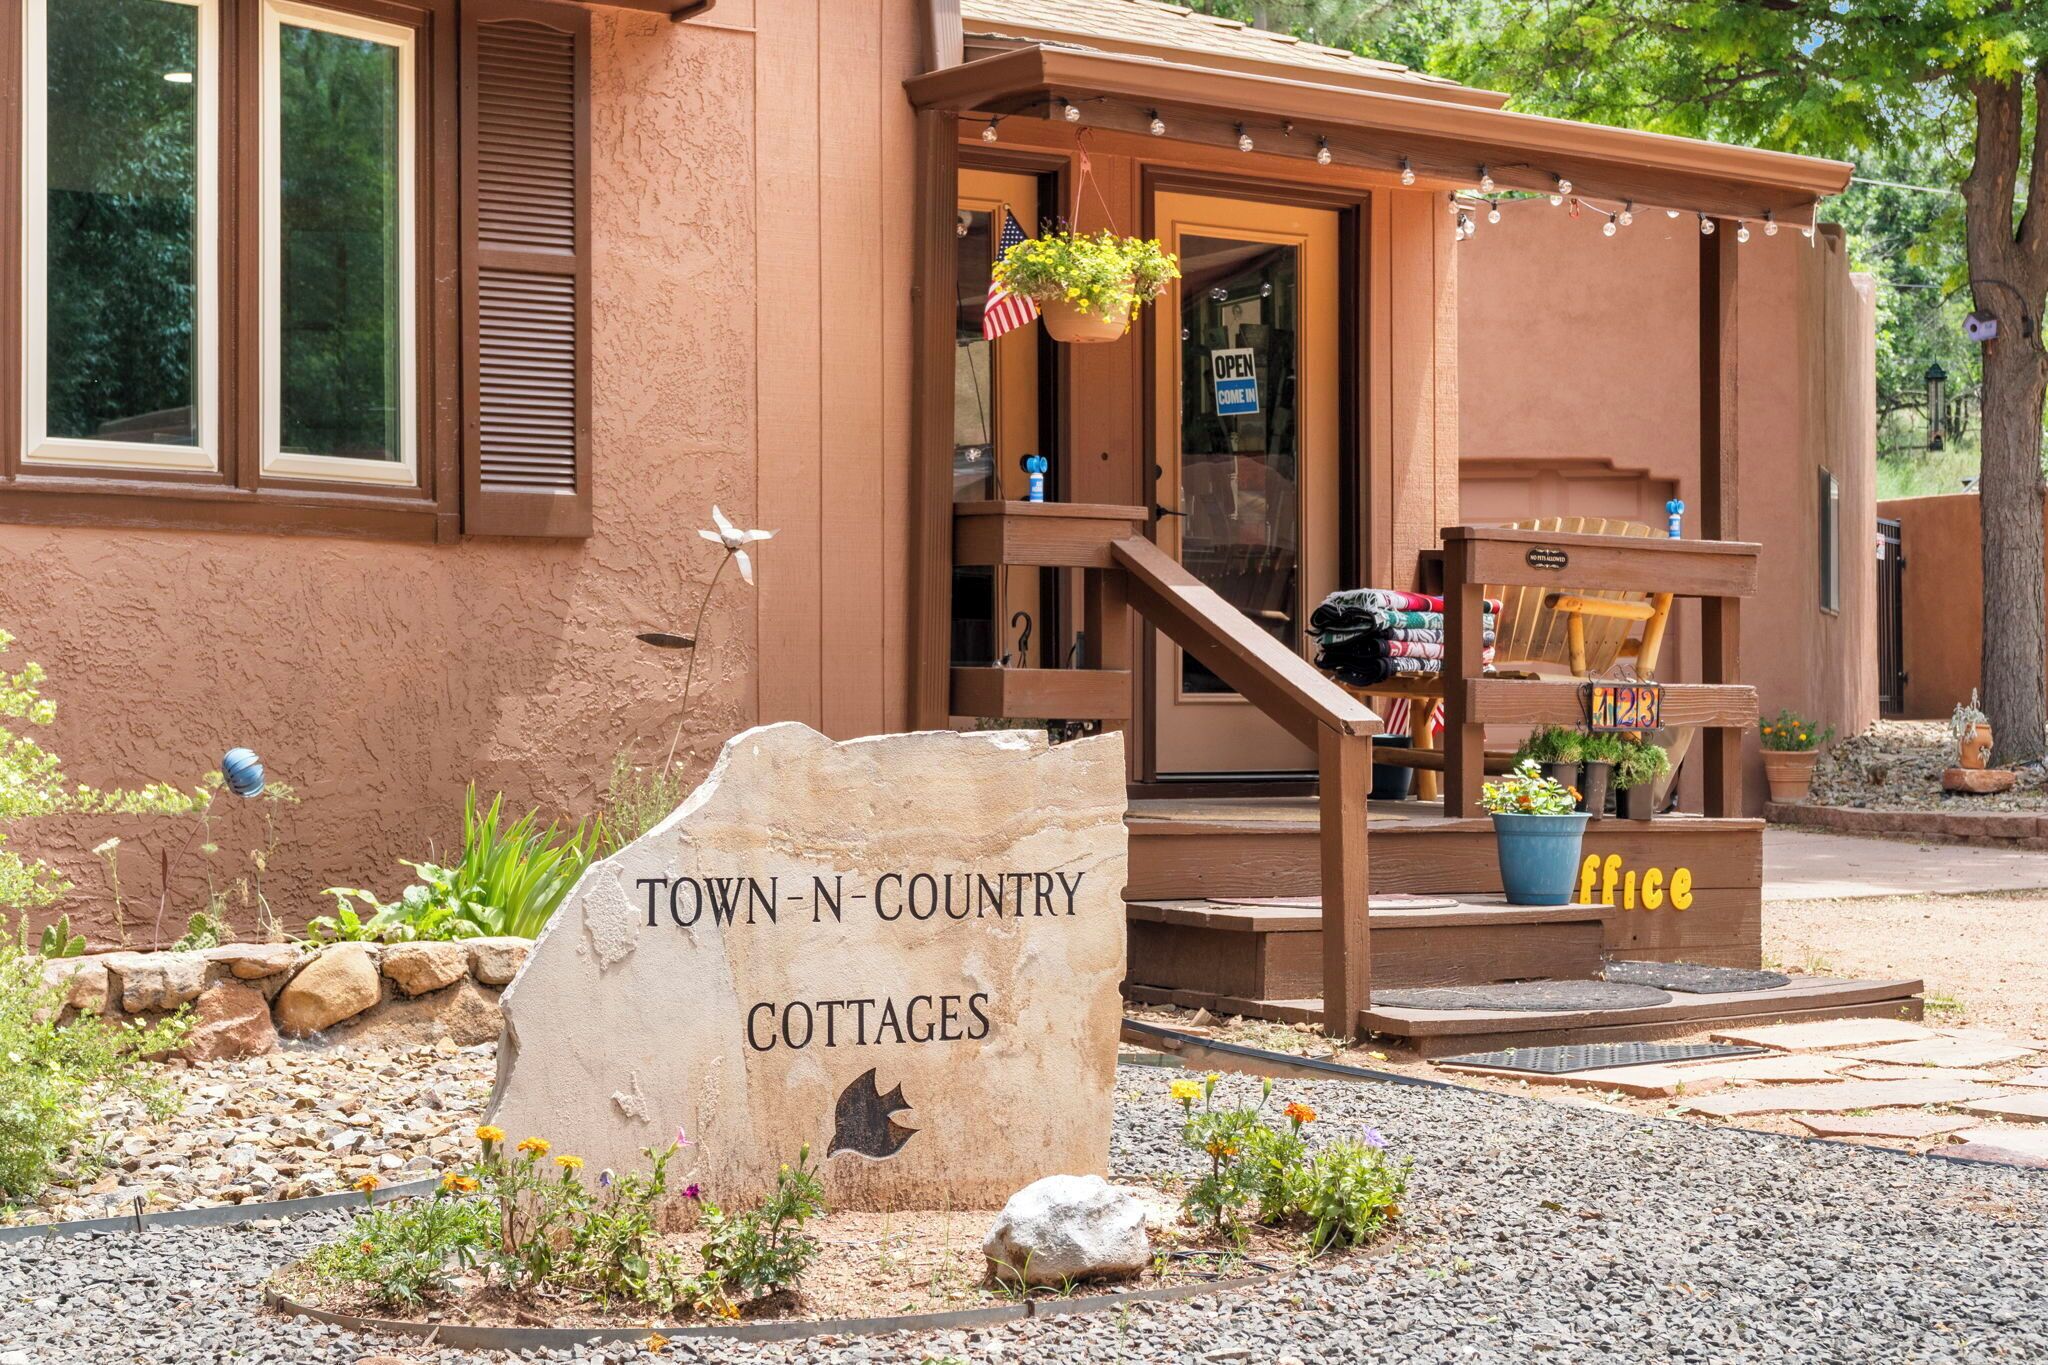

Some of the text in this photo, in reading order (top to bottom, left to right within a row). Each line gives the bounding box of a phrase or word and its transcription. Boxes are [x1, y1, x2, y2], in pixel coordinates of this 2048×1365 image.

[1215, 354, 1254, 379] OPEN
[1218, 388, 1256, 405] COME IN
[1546, 555, 1566, 563] ALLOWED
[1598, 687, 1655, 728] 123
[1580, 854, 1693, 910] ffice
[747, 992, 991, 1053] COTTAGES
